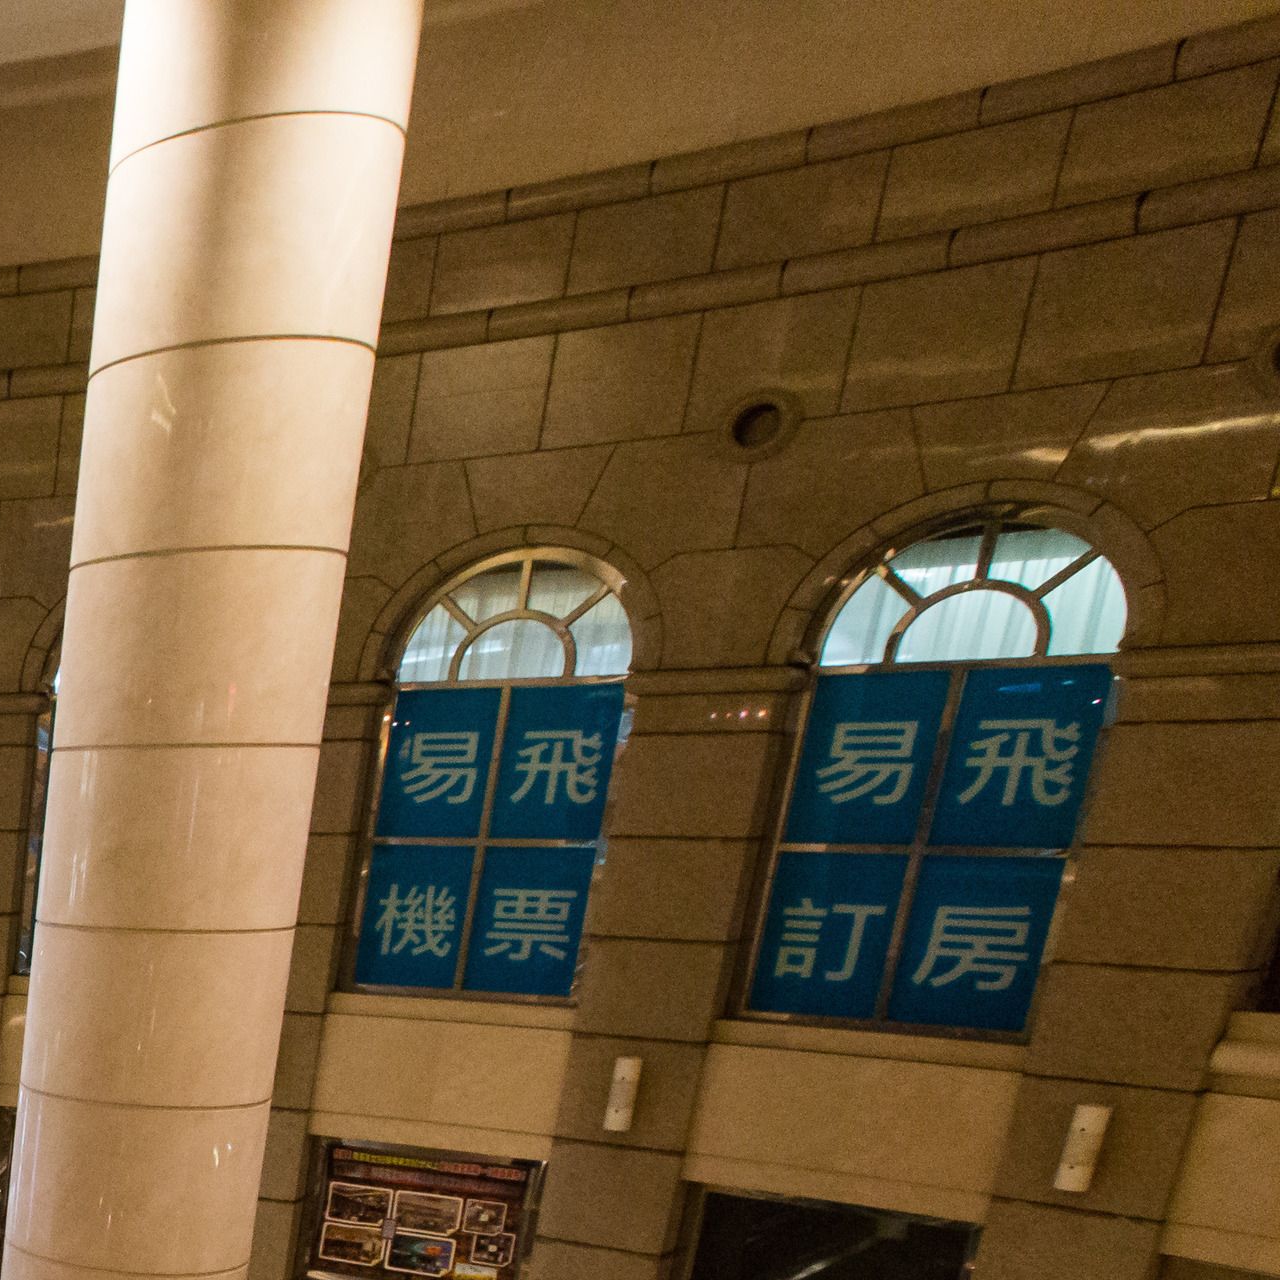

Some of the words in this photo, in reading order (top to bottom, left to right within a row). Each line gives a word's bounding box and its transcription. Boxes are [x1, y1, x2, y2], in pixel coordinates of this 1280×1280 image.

[400, 729, 603, 807] 易飛
[816, 716, 1082, 807] 易飛
[374, 883, 578, 962] 機票
[774, 897, 1031, 992] 訂房
